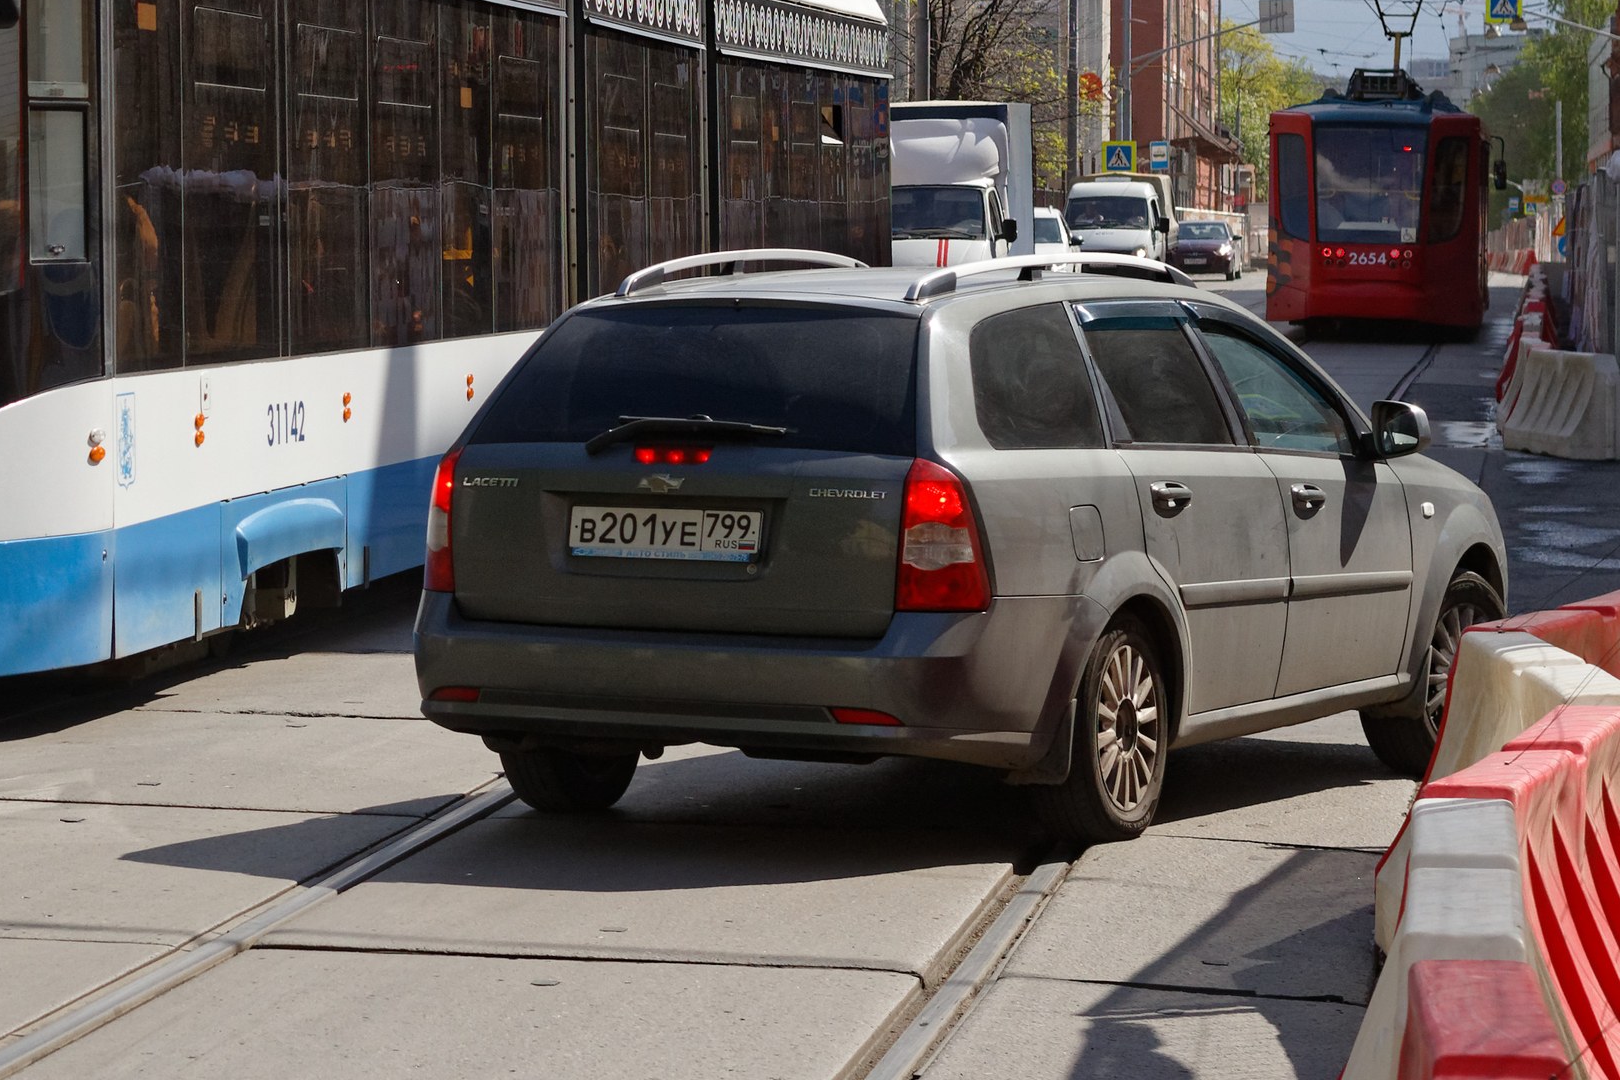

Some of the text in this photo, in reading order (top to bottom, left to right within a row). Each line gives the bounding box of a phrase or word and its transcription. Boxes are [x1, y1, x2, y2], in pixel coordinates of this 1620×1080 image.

[1348, 252, 1387, 265] 2654
[267, 400, 305, 447] 31142
[463, 476, 519, 487] LACETTI
[809, 488, 888, 499] CHEVROLET
[579, 511, 751, 547] В201УЕ 799
[714, 539, 738, 549] RUS
